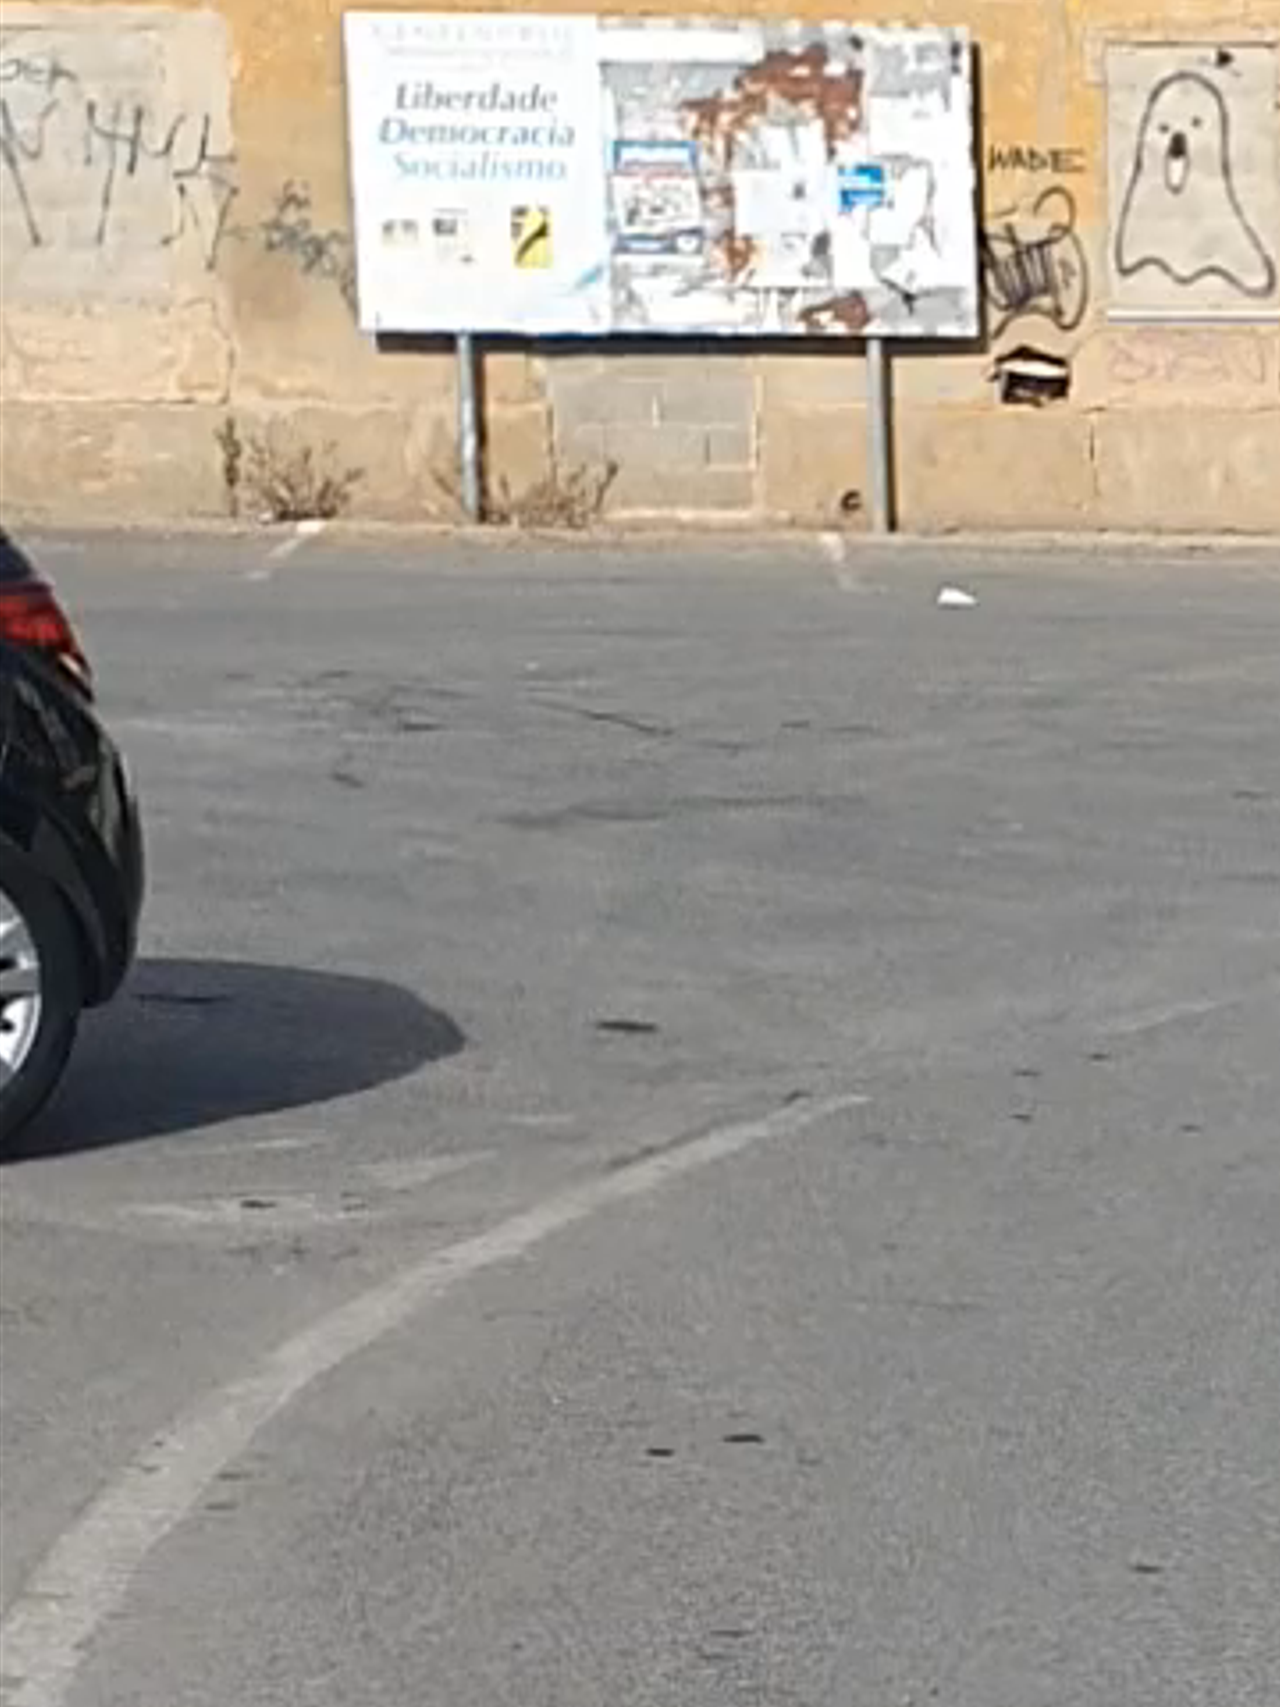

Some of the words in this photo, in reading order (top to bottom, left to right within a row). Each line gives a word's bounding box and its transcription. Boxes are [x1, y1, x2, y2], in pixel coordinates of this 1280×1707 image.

[395, 82, 558, 111] Liberdade
[378, 116, 576, 147] Democracia
[394, 151, 567, 180] Socialismo
